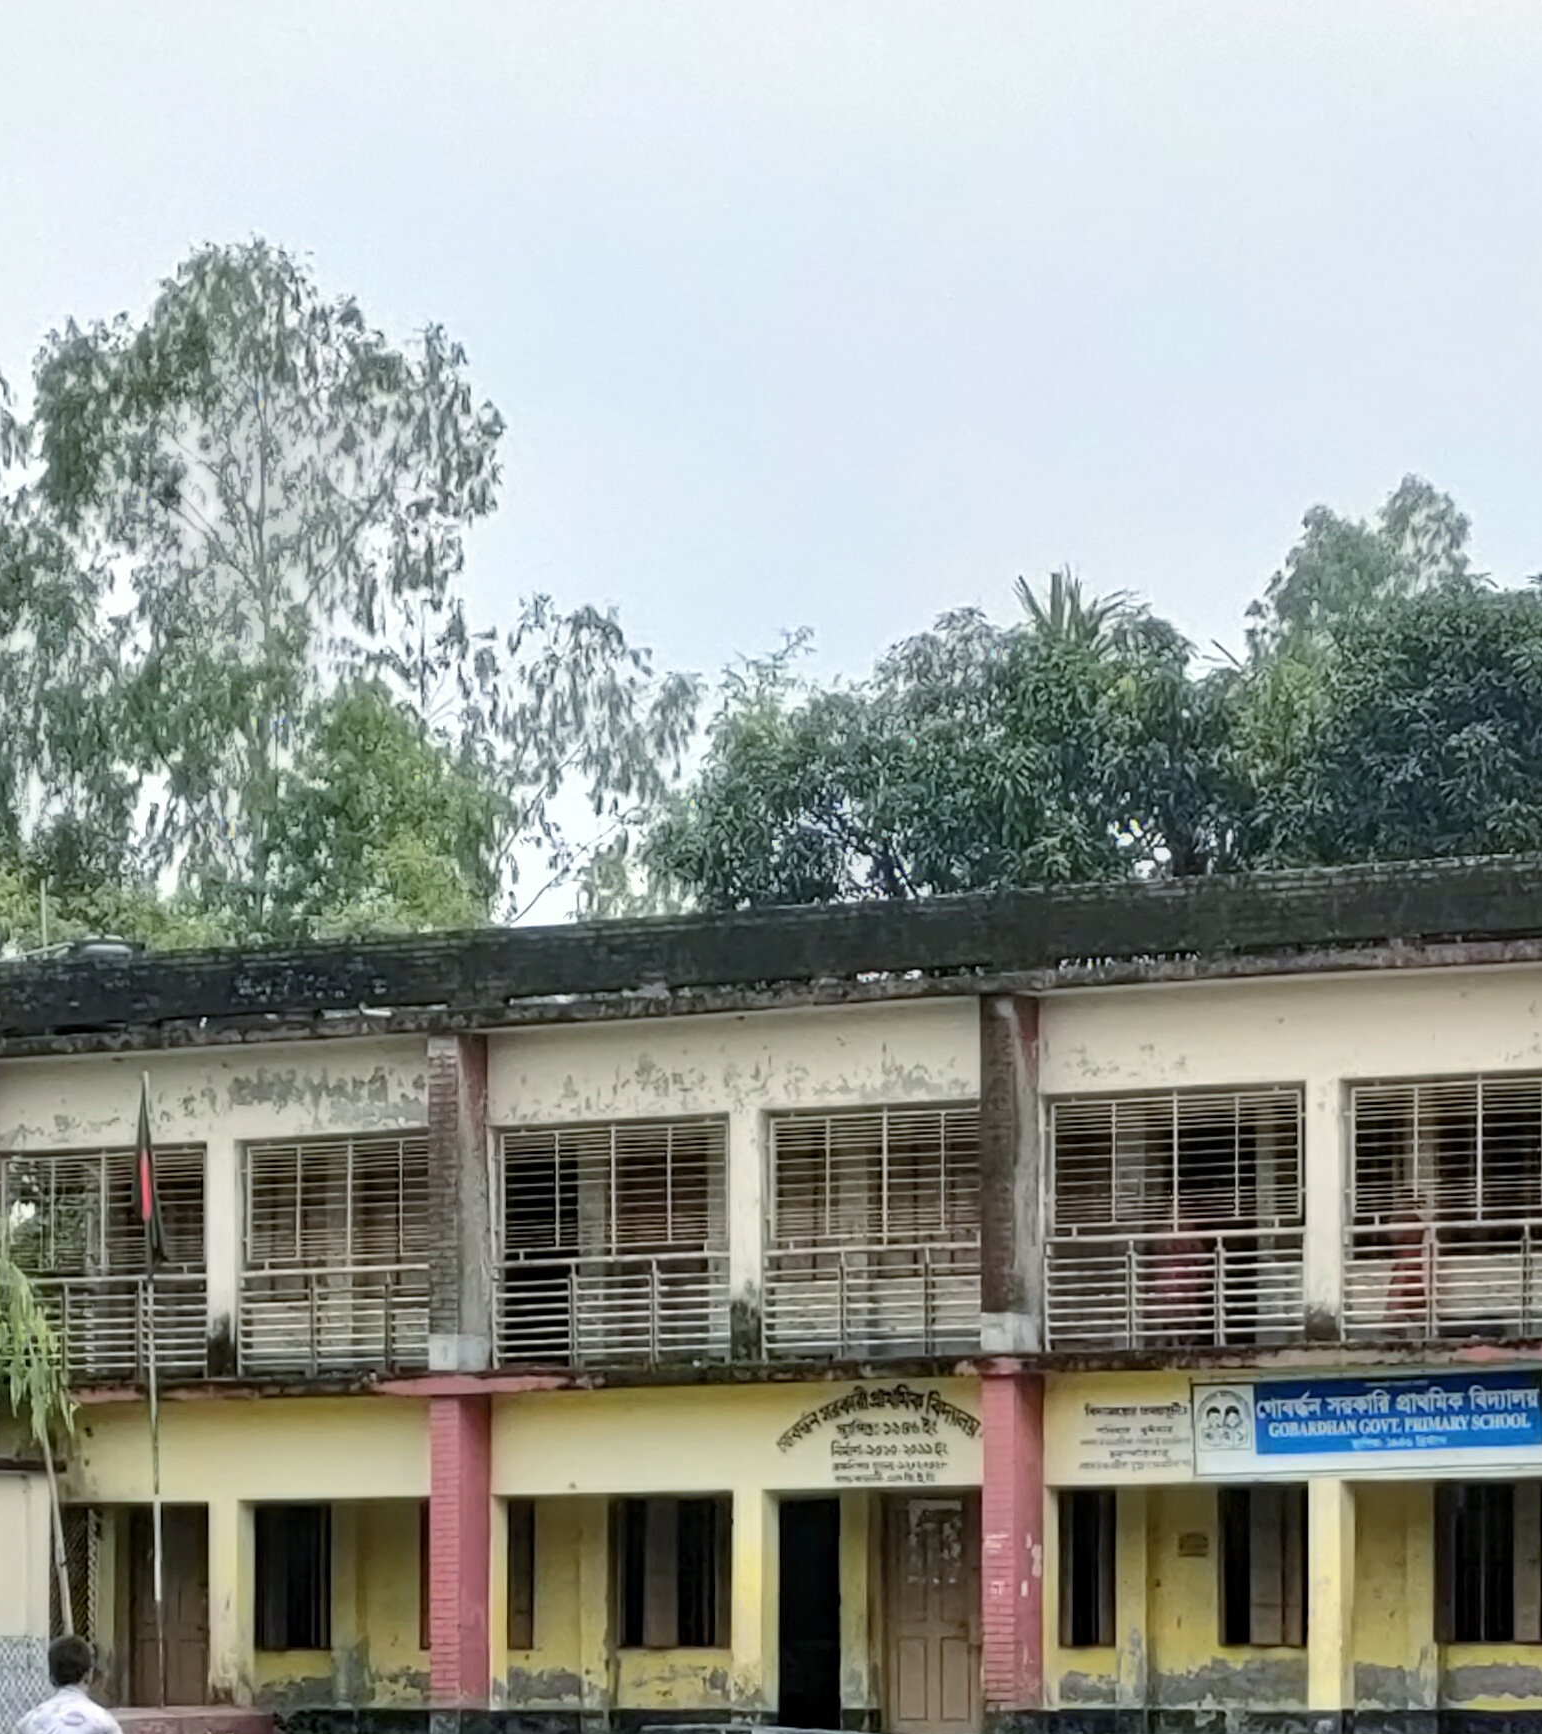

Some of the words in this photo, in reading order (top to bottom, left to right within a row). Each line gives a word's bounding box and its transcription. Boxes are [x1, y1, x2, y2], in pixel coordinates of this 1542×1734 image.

[868, 1383, 925, 1411] প্রাথমিক
[1325, 1389, 1390, 1416] সরকারি
[1395, 1386, 1464, 1414] প্রাথমিক
[1468, 1385, 1539, 1410] বিদ্যালয়
[1268, 1419, 1358, 1438] GOBARDHAN
[1404, 1414, 1469, 1433] PRIMARY
[1471, 1412, 1532, 1430] SCHOOL
